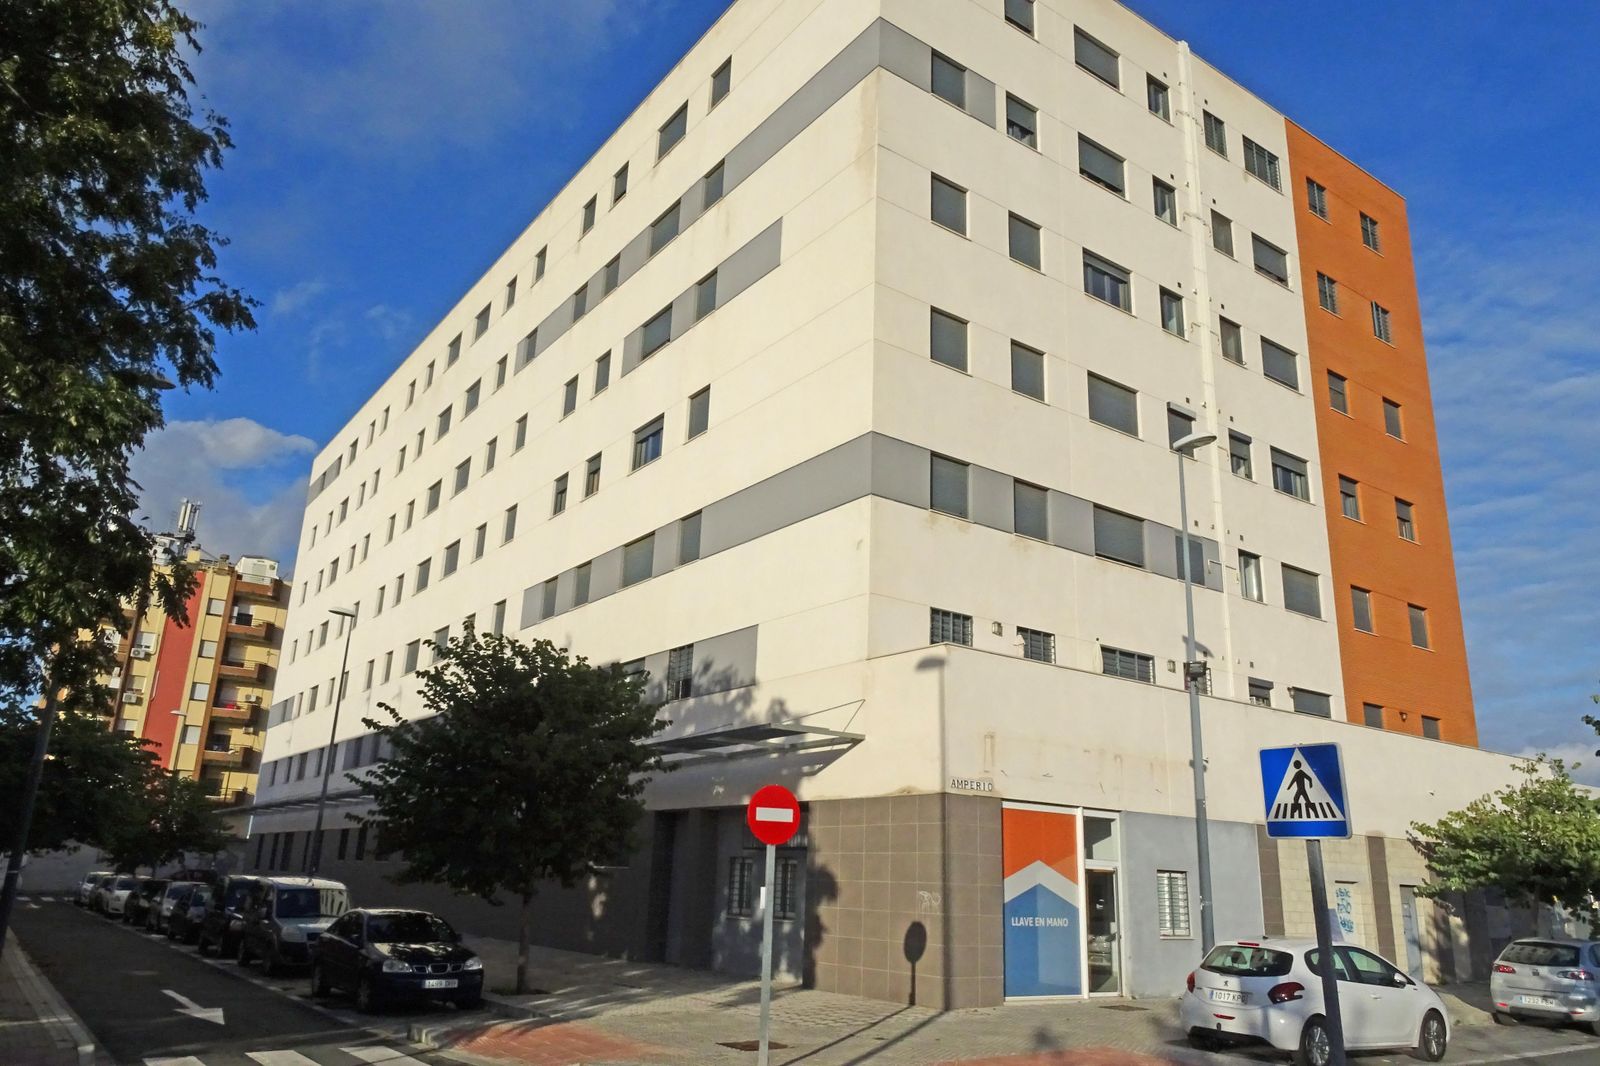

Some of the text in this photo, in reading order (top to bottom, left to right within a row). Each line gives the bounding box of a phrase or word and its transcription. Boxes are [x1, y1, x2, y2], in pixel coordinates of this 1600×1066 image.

[951, 779, 993, 792] AMPERIO
[1011, 916, 1069, 927] LLAVE EN MANO
[1215, 991, 1231, 1001] 1017
